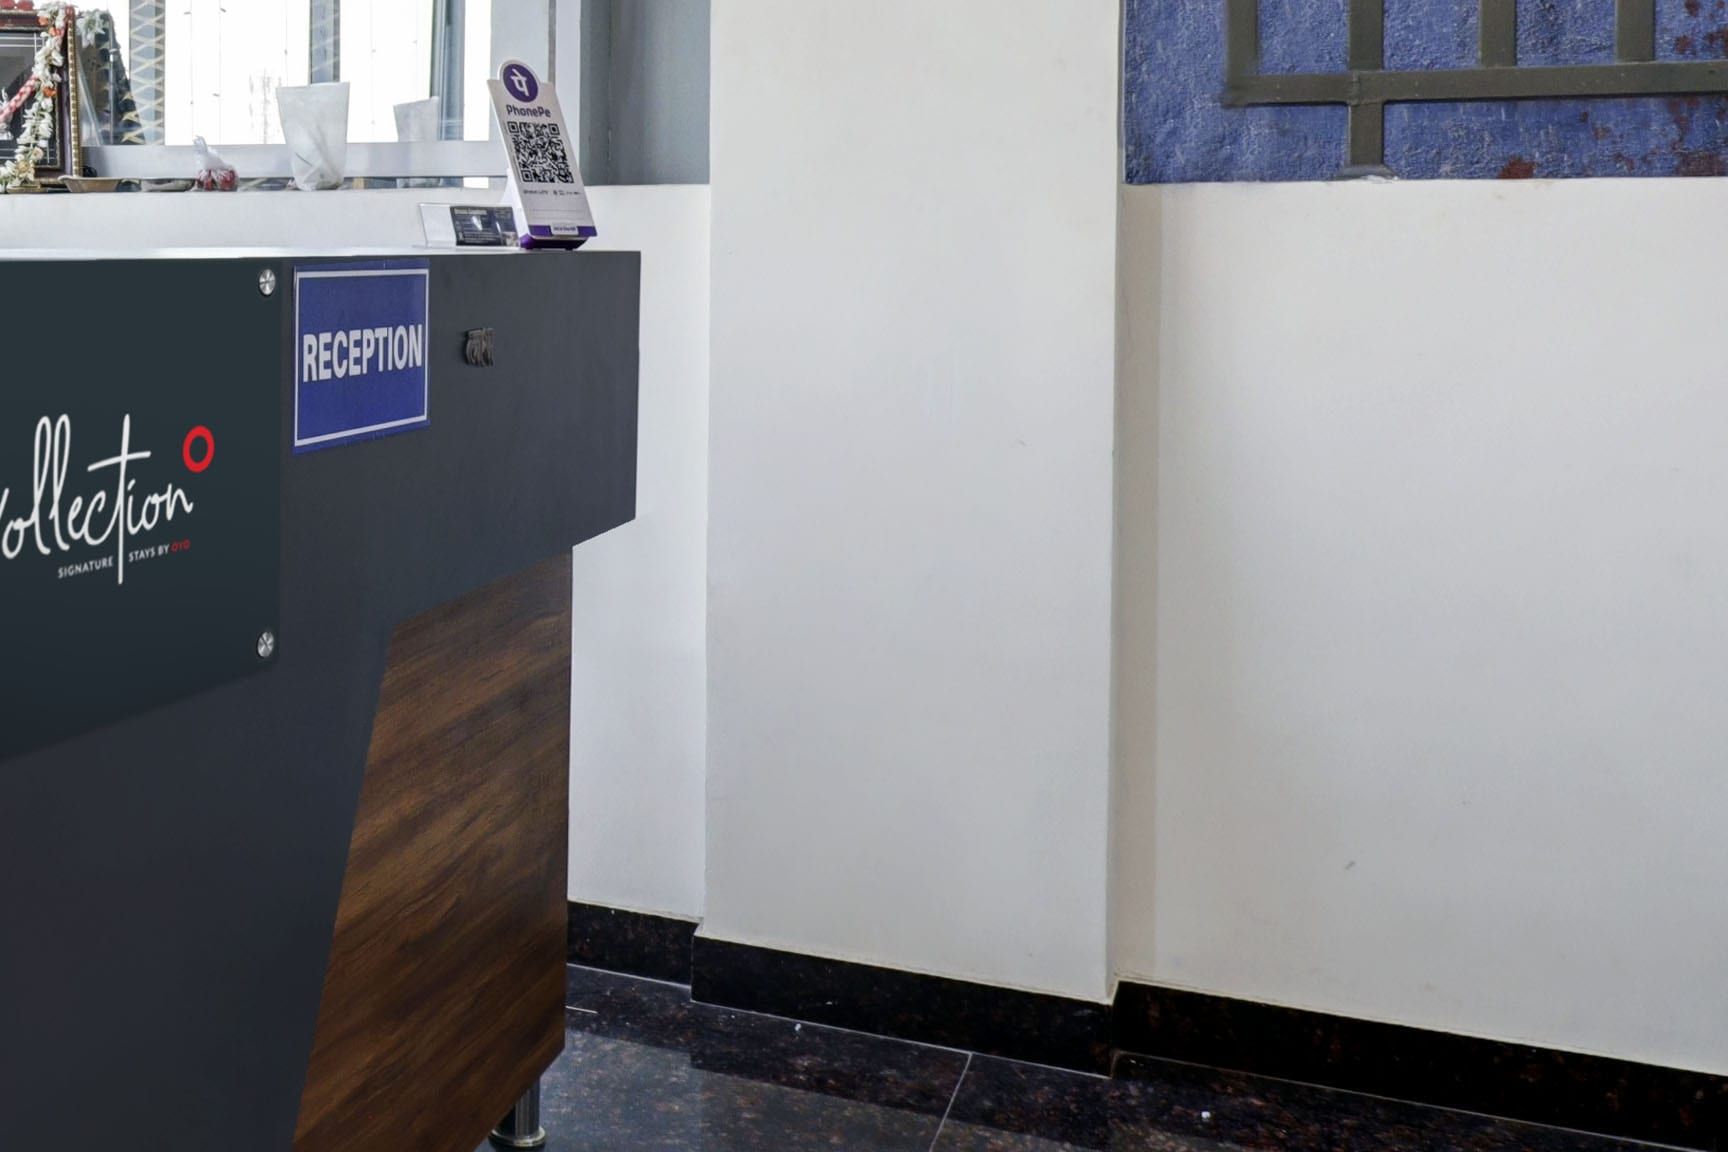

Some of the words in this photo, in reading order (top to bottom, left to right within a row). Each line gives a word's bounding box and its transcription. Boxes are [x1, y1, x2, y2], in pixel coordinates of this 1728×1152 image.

[506, 104, 552, 118] PhonePe
[302, 323, 424, 383] RECEPTION
[58, 555, 114, 579] SIGNATURE
[128, 546, 156, 563] STAYS
[157, 544, 170, 557] BY
[170, 539, 192, 552] OYO
